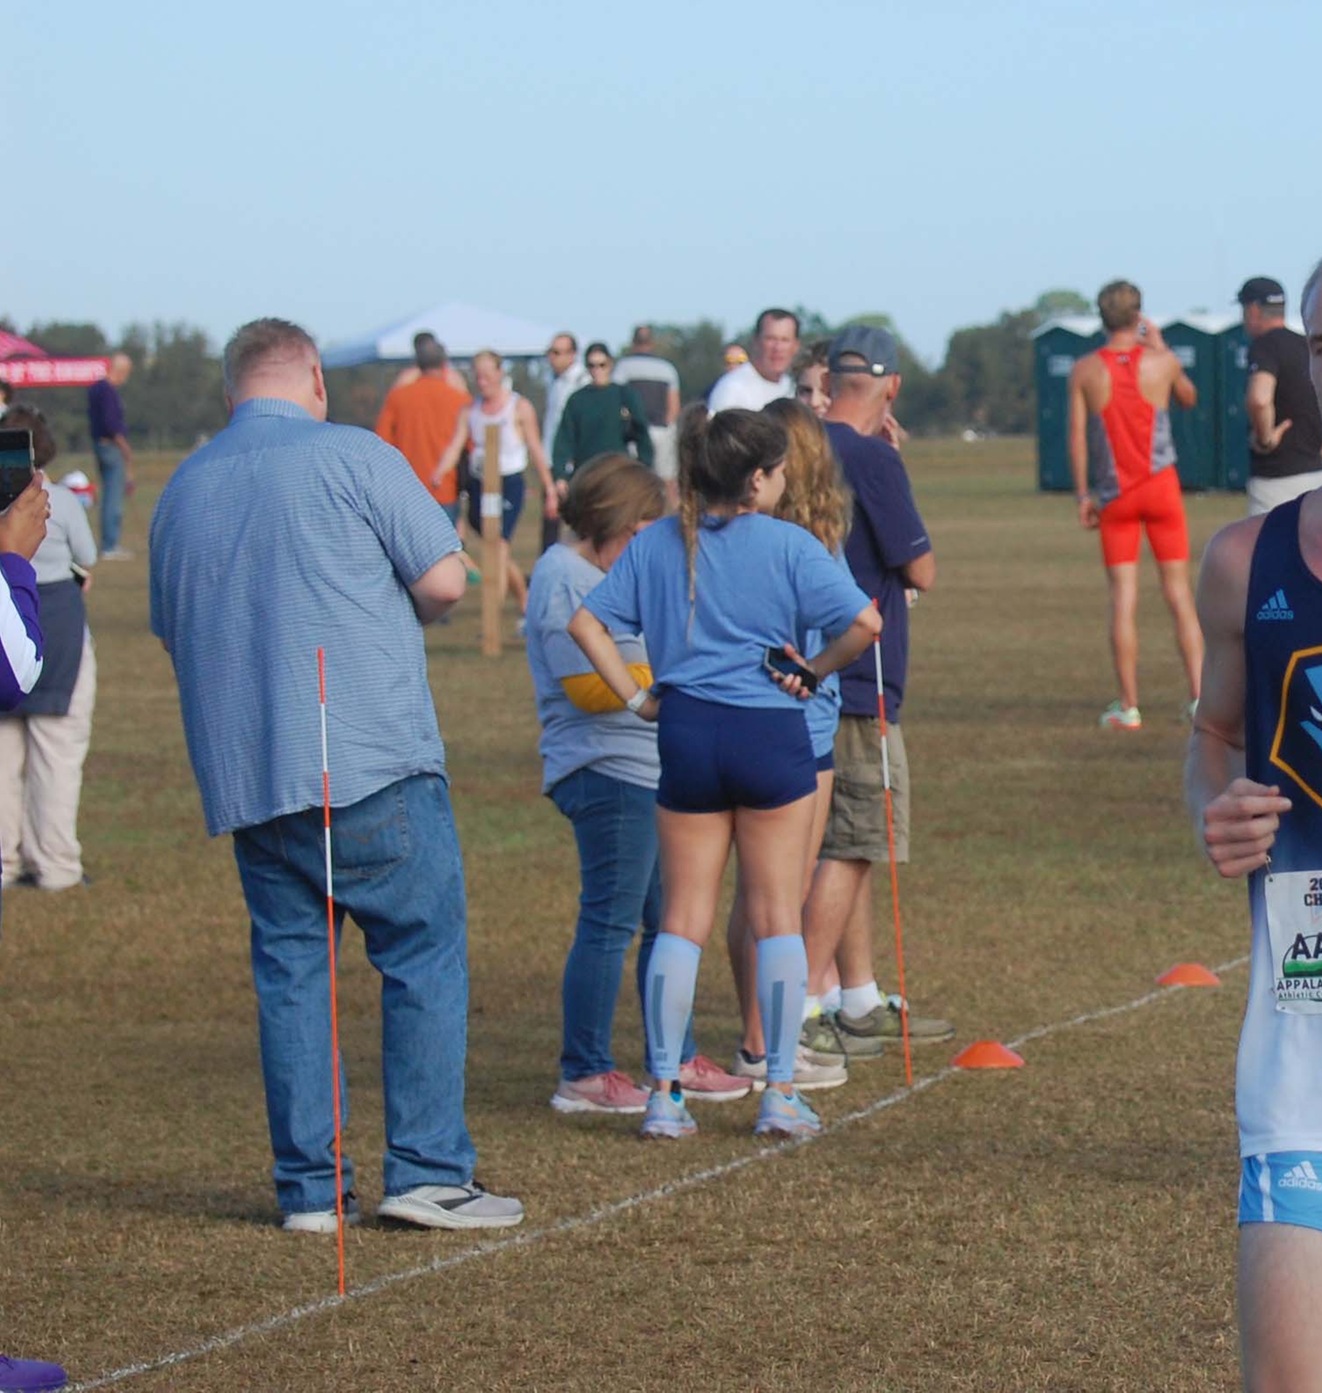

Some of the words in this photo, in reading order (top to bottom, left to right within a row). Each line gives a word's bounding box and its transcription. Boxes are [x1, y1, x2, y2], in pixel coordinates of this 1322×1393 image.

[1256, 609, 1294, 620] adidas
[1278, 990, 1313, 999] Athletic
[1278, 1177, 1322, 1191] adidas
